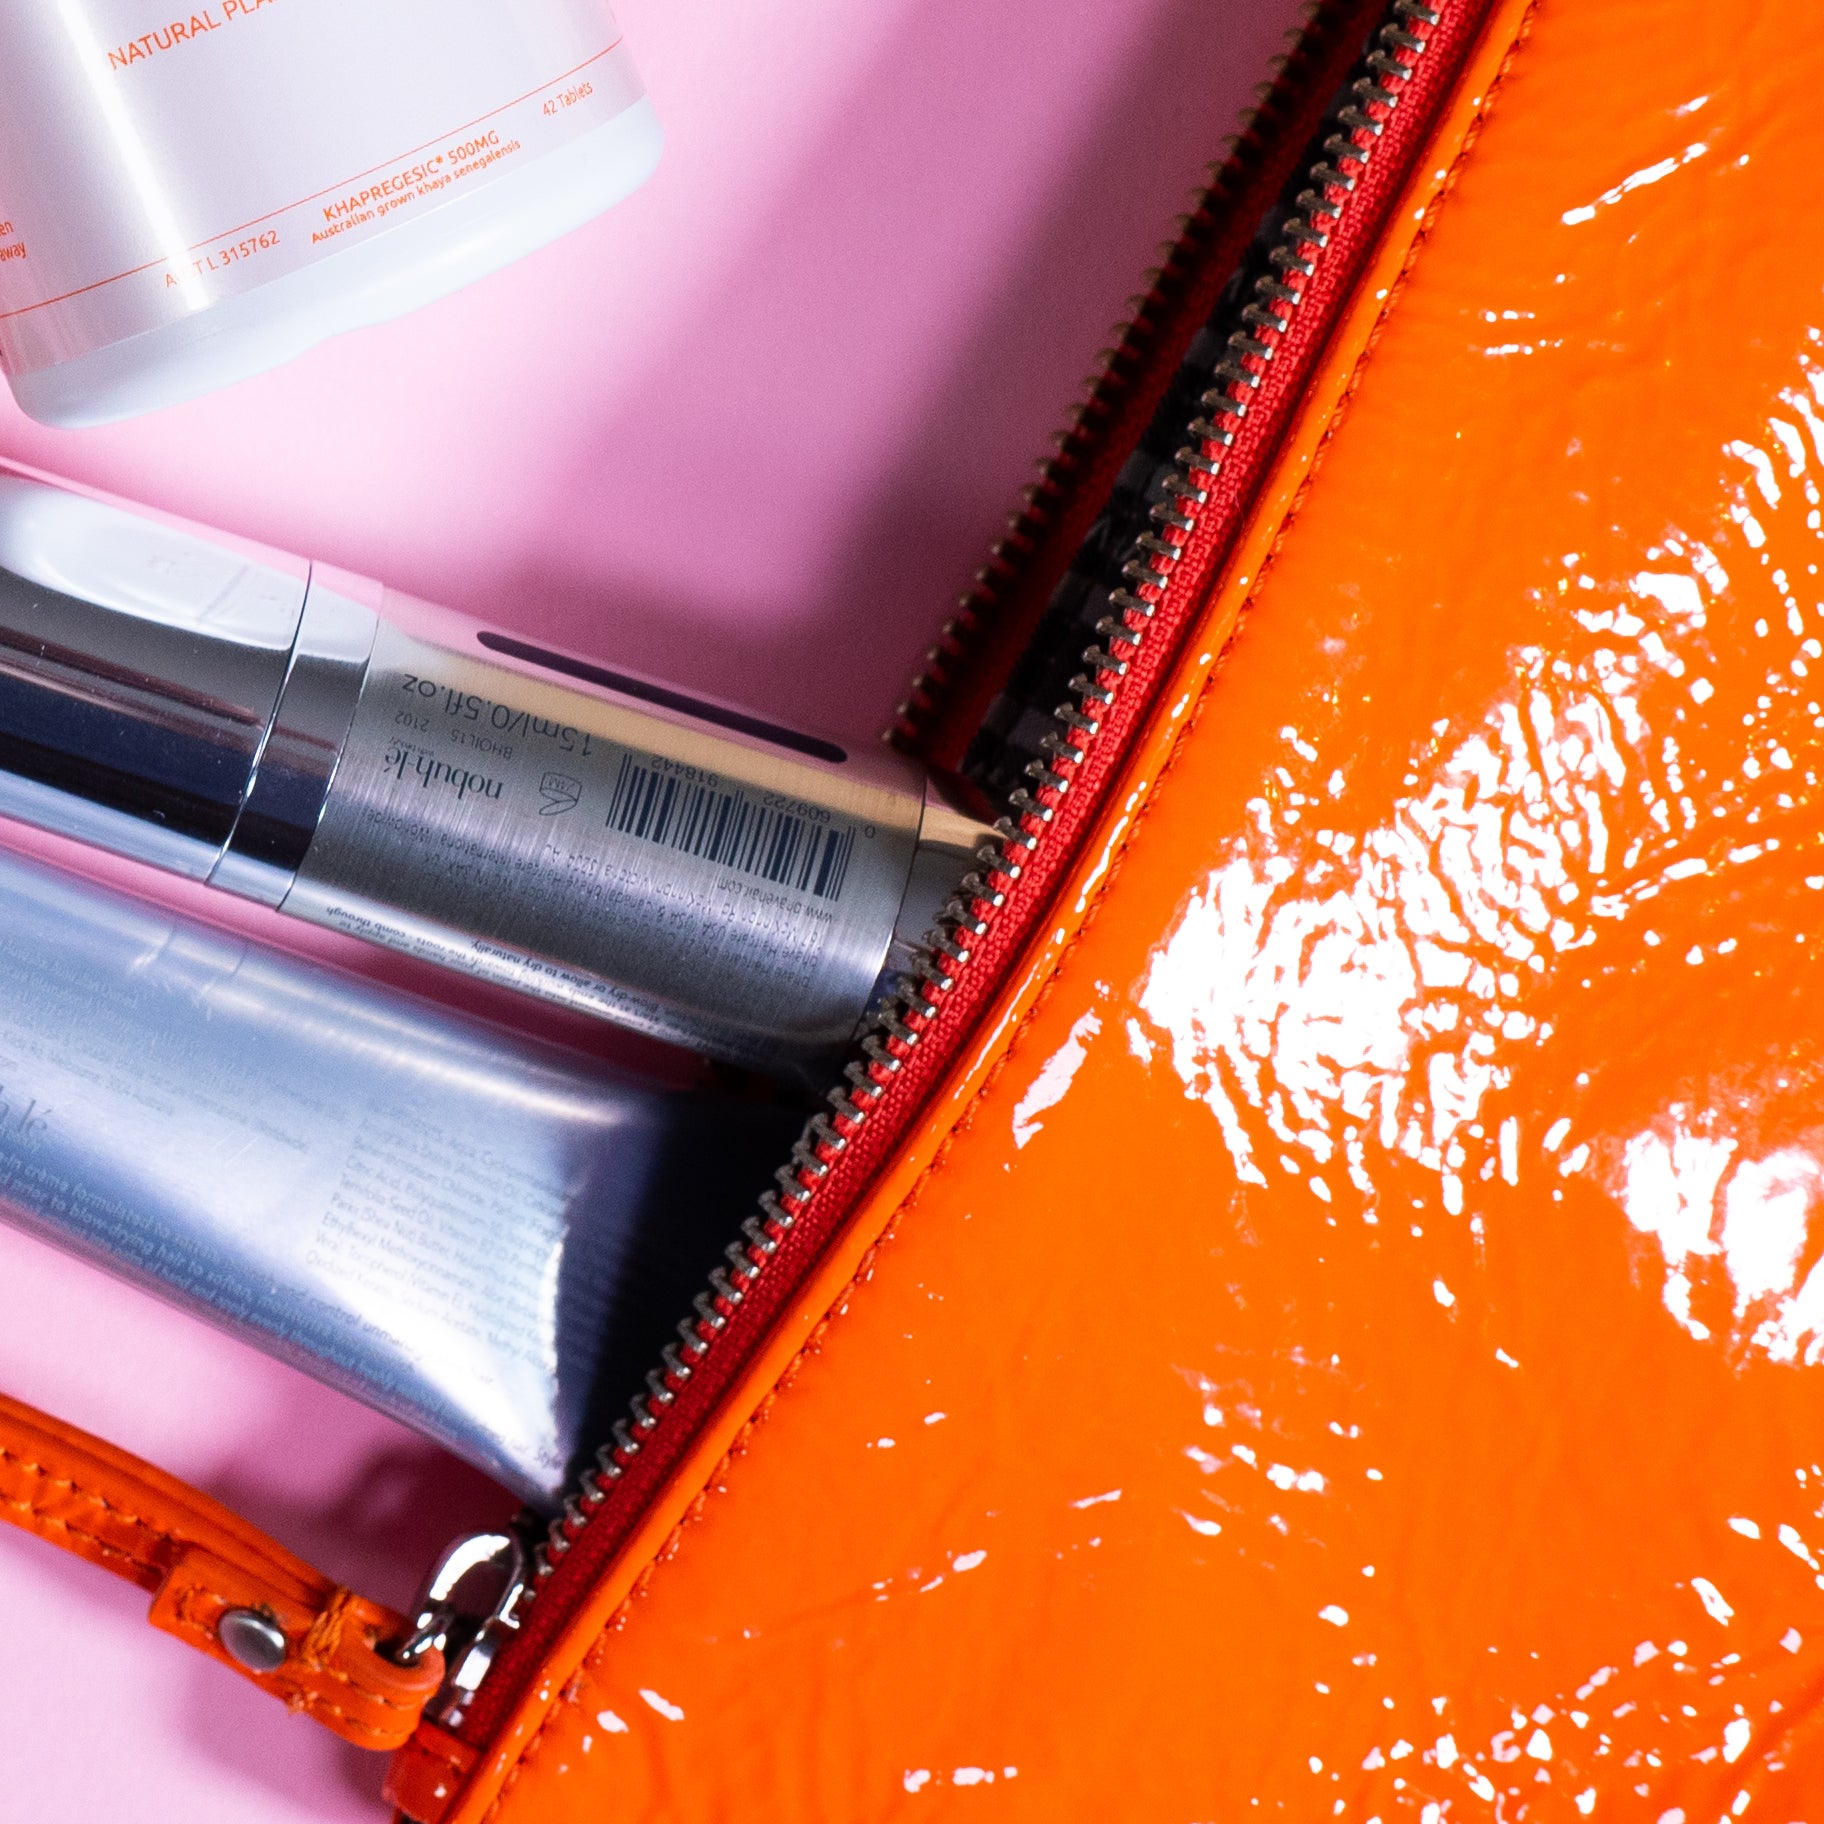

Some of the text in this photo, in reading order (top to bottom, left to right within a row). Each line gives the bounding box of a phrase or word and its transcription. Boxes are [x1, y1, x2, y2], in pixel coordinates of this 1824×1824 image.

[108, 11, 221, 68] NATURAL
[544, 83, 592, 114] 42 Tablets
[443, 127, 504, 168] 500MG
[308, 135, 524, 247] Australian grown khaya senegalensis
[160, 227, 282, 290] AT L 315762
[391, 708, 515, 760] BHOIL15 2102
[395, 671, 599, 760] 15ml/0.5fl.oz
[377, 743, 506, 812] nobuh-lé
[648, 753, 878, 841] 0 609722 918442
[323, 903, 373, 928] through
[372, 921, 407, 940] comb
[520, 956, 544, 974] dry
[541, 966, 558, 979] to
